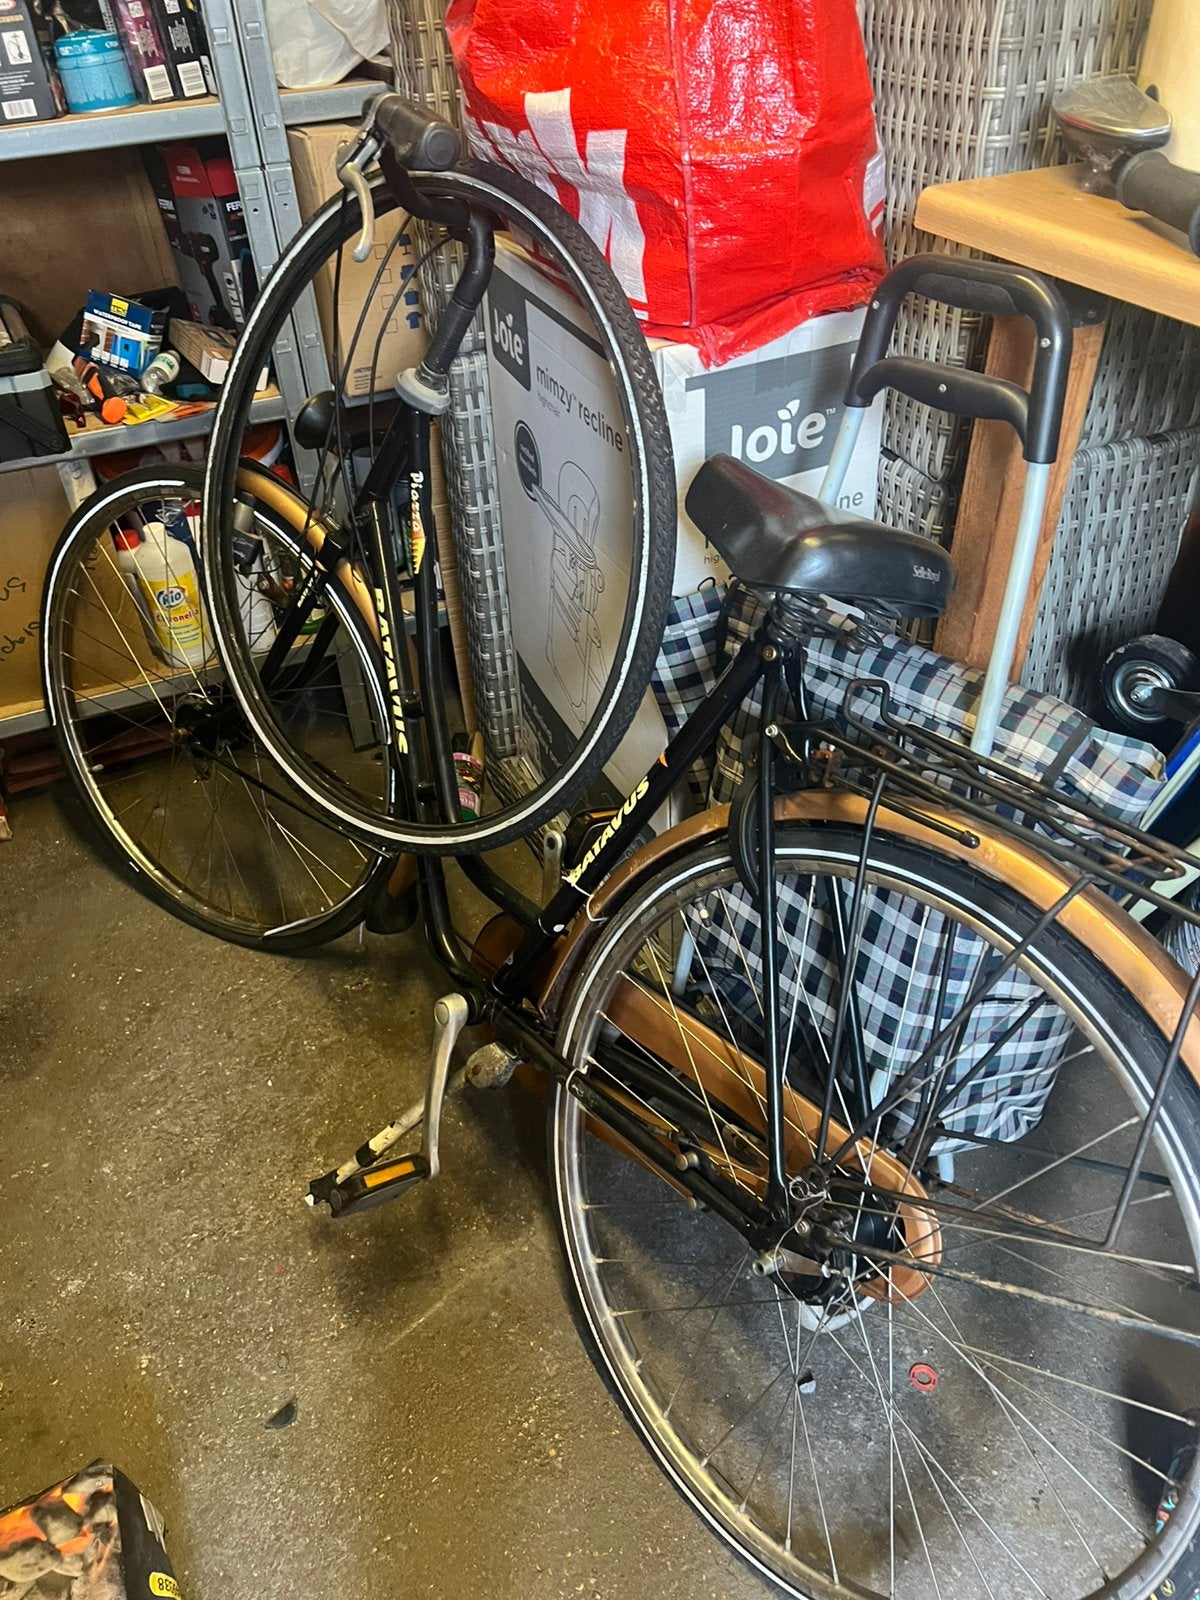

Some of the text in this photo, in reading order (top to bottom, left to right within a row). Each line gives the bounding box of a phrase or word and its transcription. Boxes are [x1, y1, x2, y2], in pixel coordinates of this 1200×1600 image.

[226, 201, 241, 212] FER
[494, 308, 523, 366] Joie
[578, 402, 623, 452] recline
[162, 590, 182, 605] Rio
[375, 587, 410, 755] BATAVUS
[570, 776, 650, 886] BATAVUS
